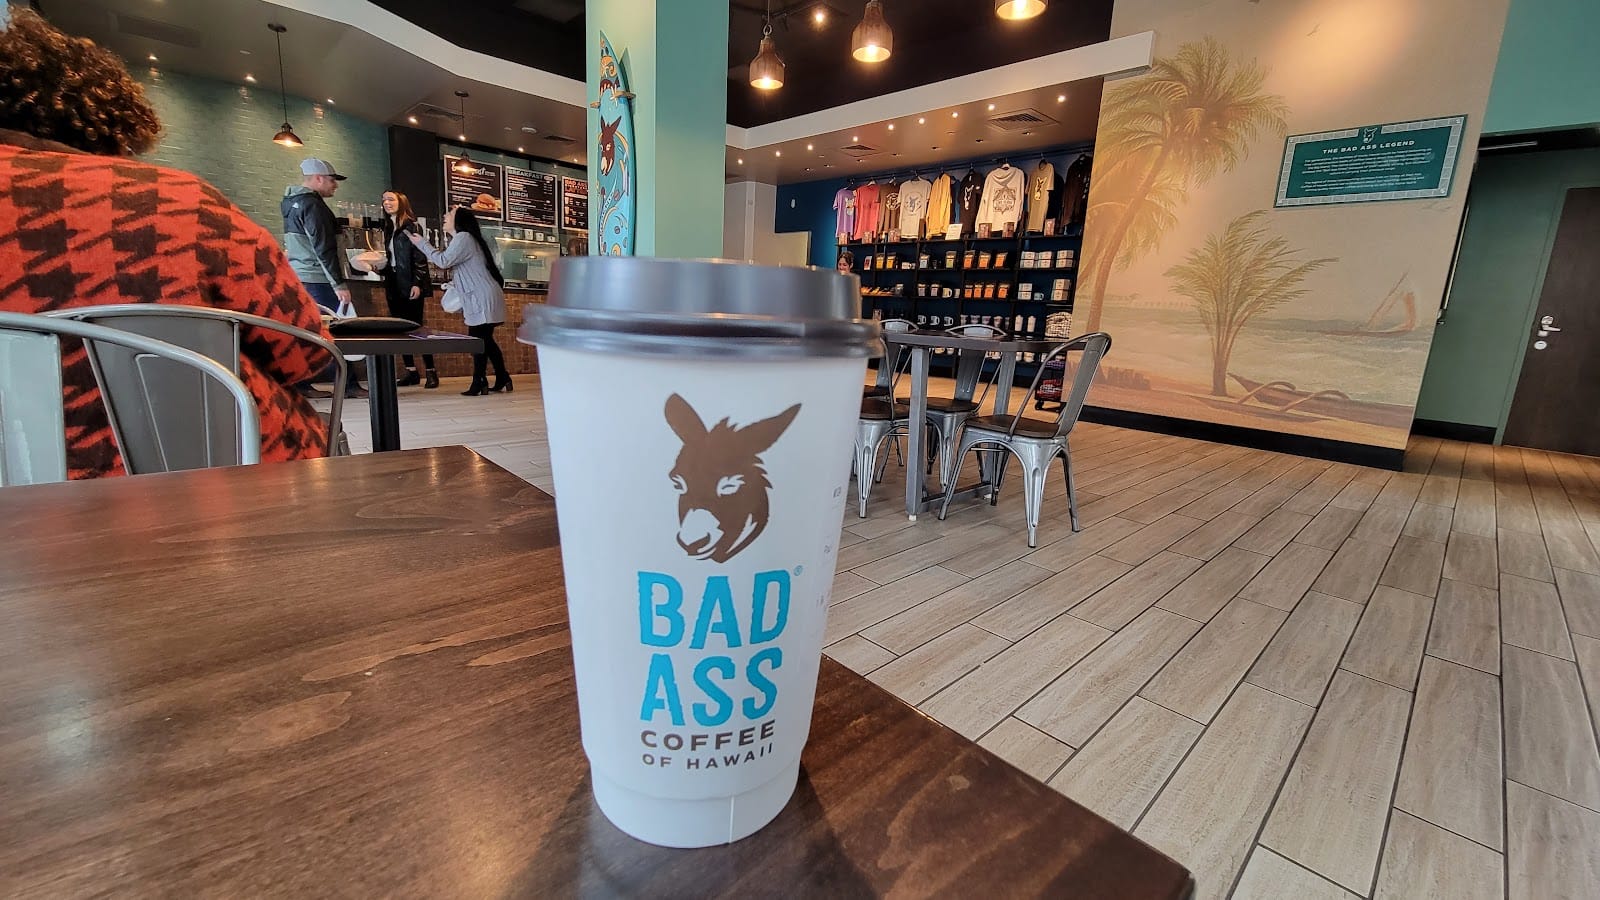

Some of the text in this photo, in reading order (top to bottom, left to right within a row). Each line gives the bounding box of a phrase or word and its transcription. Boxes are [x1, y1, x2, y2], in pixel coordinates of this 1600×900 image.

[1322, 139, 1416, 155] THE BAD ASS LEGEND
[508, 169, 543, 179] BREAKFAST
[638, 570, 791, 649] BAD
[640, 647, 783, 727] ASS
[641, 719, 776, 752] COFFEE
[642, 742, 773, 770] OF HAWAII
